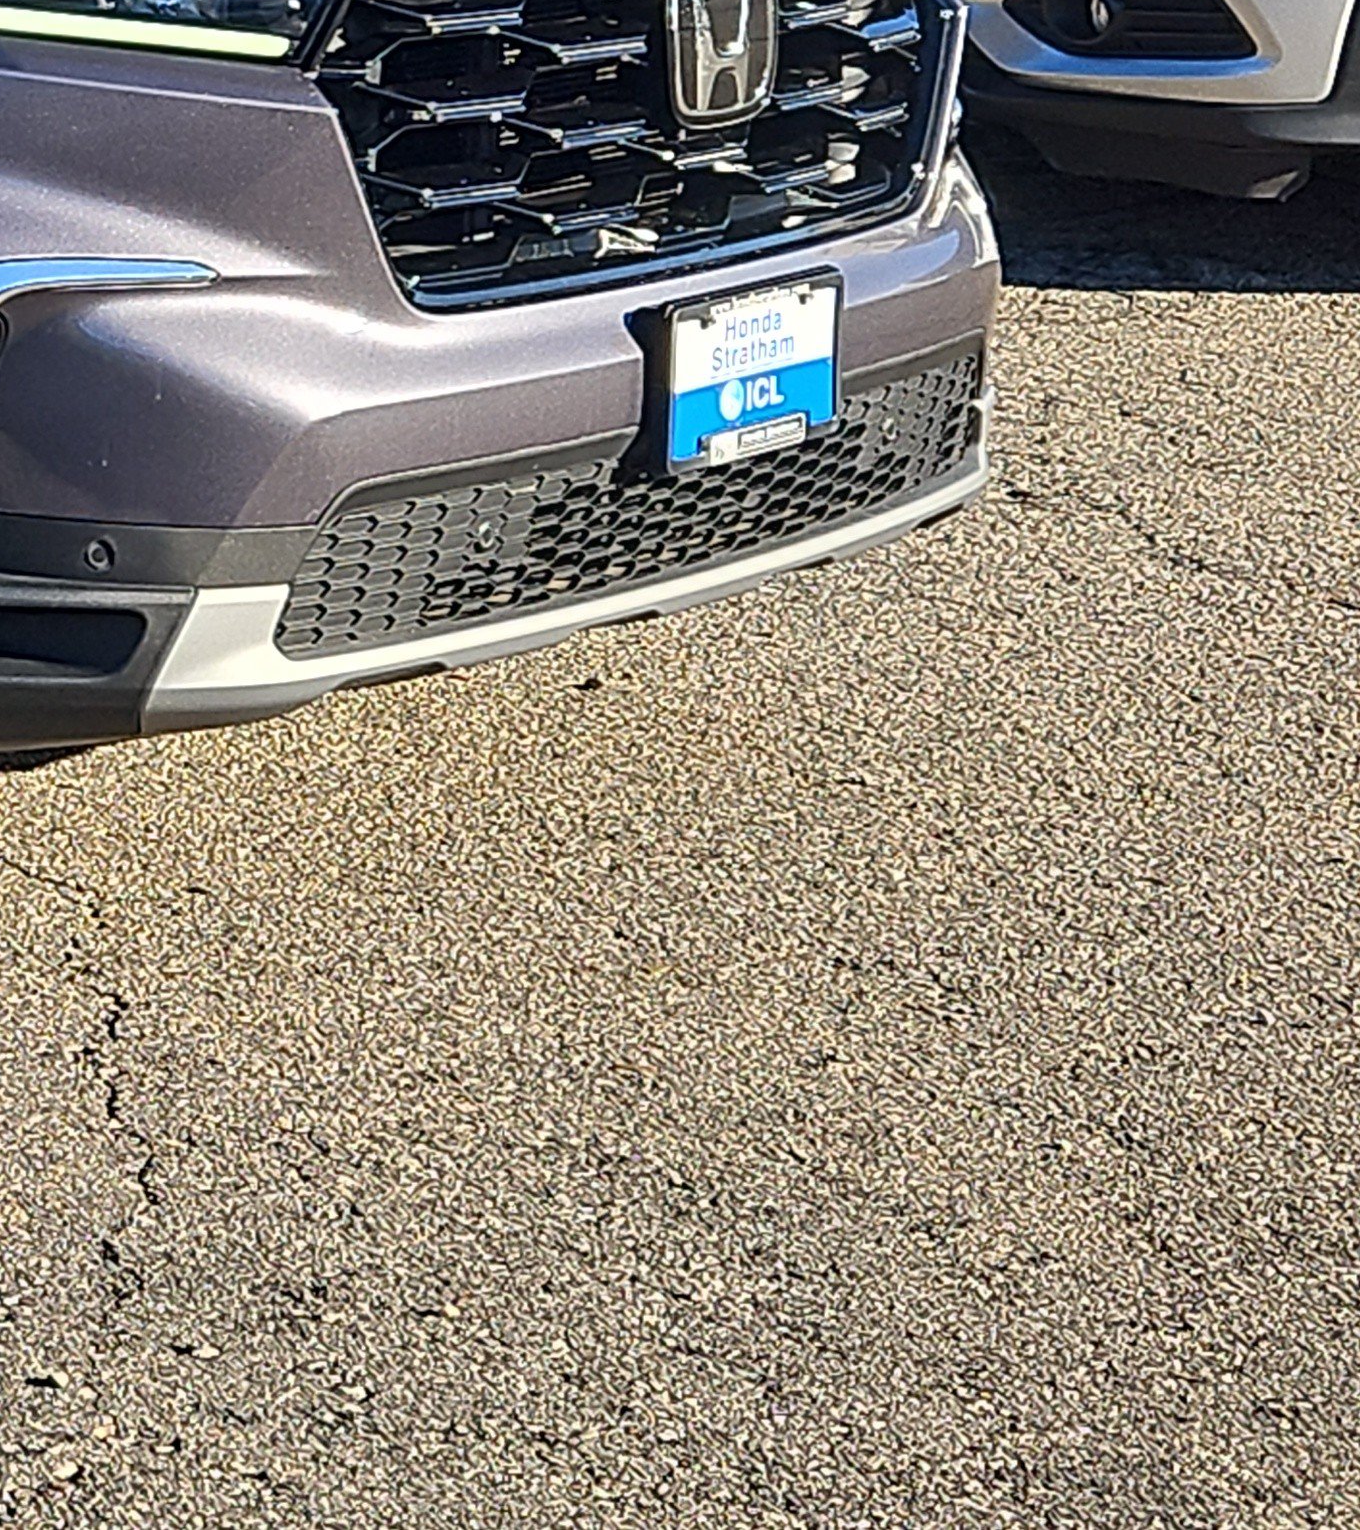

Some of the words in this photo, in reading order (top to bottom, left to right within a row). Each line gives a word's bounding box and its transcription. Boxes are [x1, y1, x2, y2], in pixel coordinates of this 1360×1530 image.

[724, 309, 782, 341] Honda
[711, 336, 794, 372] Stratham
[745, 375, 785, 411] ICL
